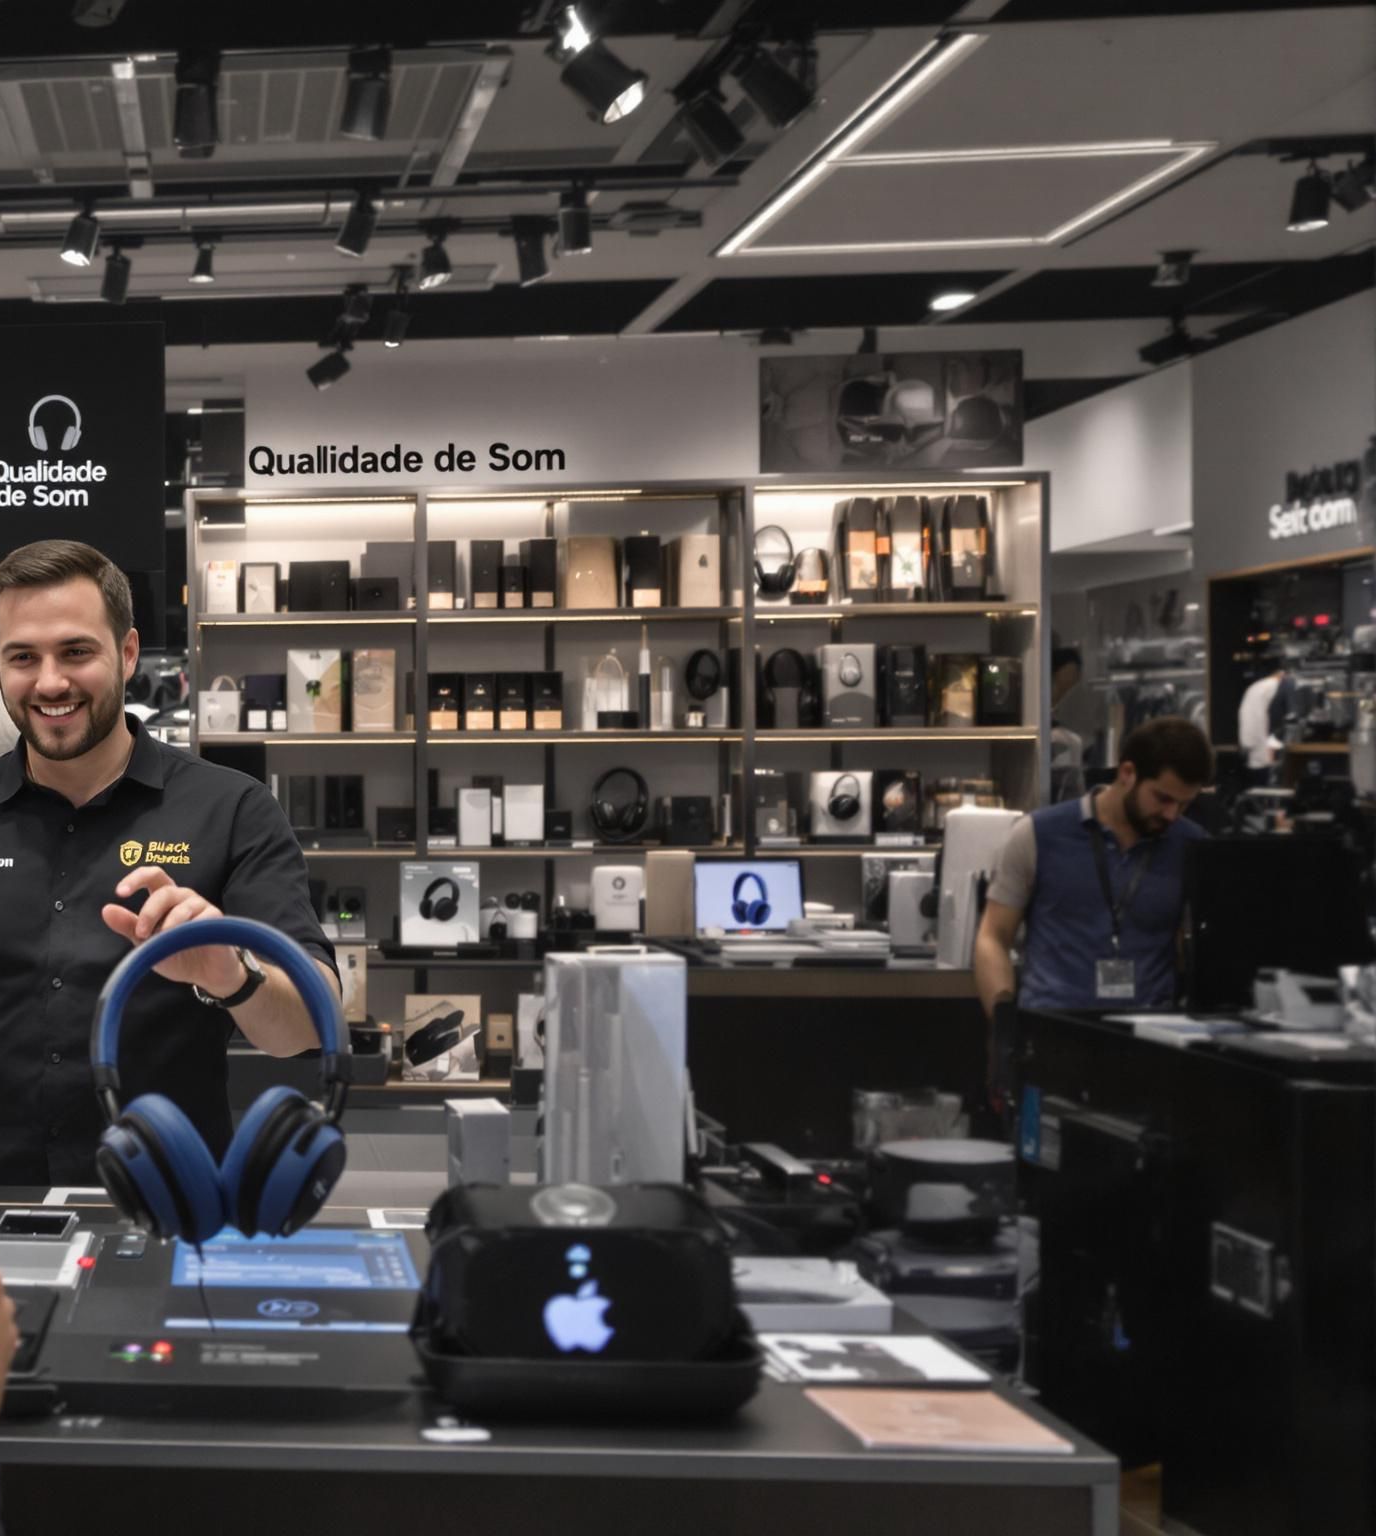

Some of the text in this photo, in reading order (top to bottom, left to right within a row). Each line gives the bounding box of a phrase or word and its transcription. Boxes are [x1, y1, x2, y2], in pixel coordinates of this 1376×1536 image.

[434, 443, 477, 472] de
[488, 442, 566, 472] Som
[32, 484, 89, 507] Som
